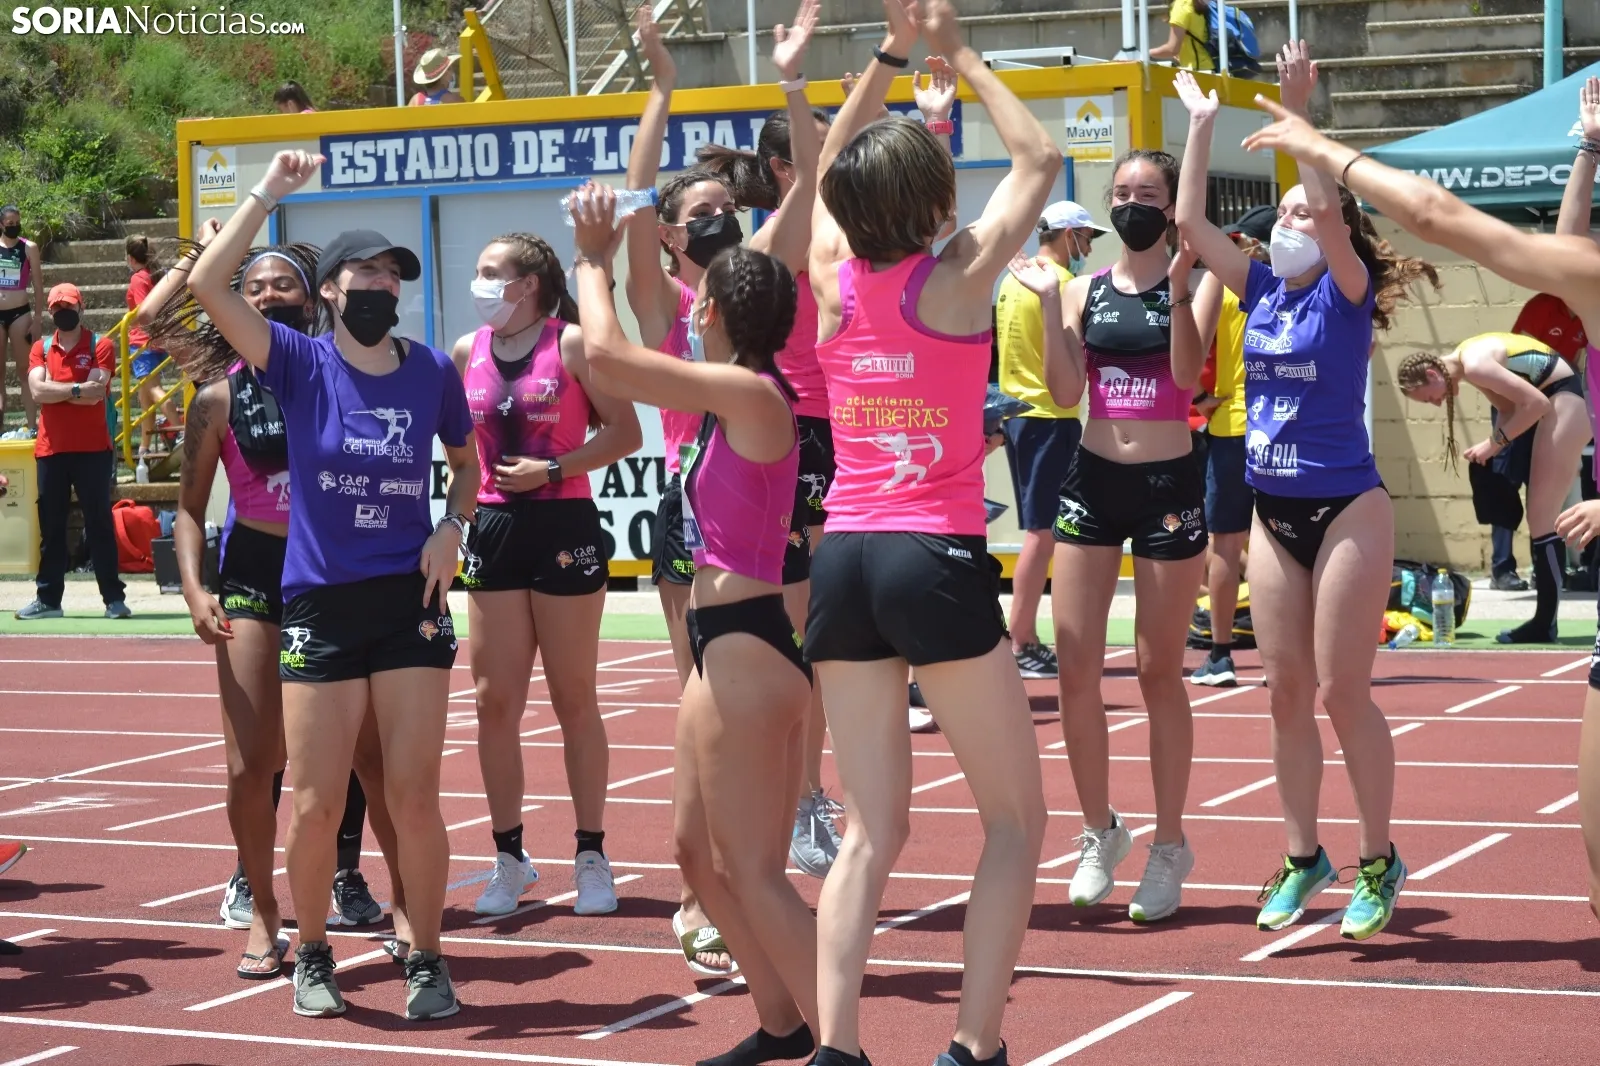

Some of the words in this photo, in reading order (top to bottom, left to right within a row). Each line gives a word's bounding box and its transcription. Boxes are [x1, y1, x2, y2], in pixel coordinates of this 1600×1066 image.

[1066, 124, 1113, 140] Mavyal
[330, 132, 500, 185] ESTADIO
[512, 129, 566, 175] DE
[199, 172, 236, 186] Mavyal
[834, 404, 950, 429] CELTIBERAS
[342, 441, 414, 458] CELTIBERAS
